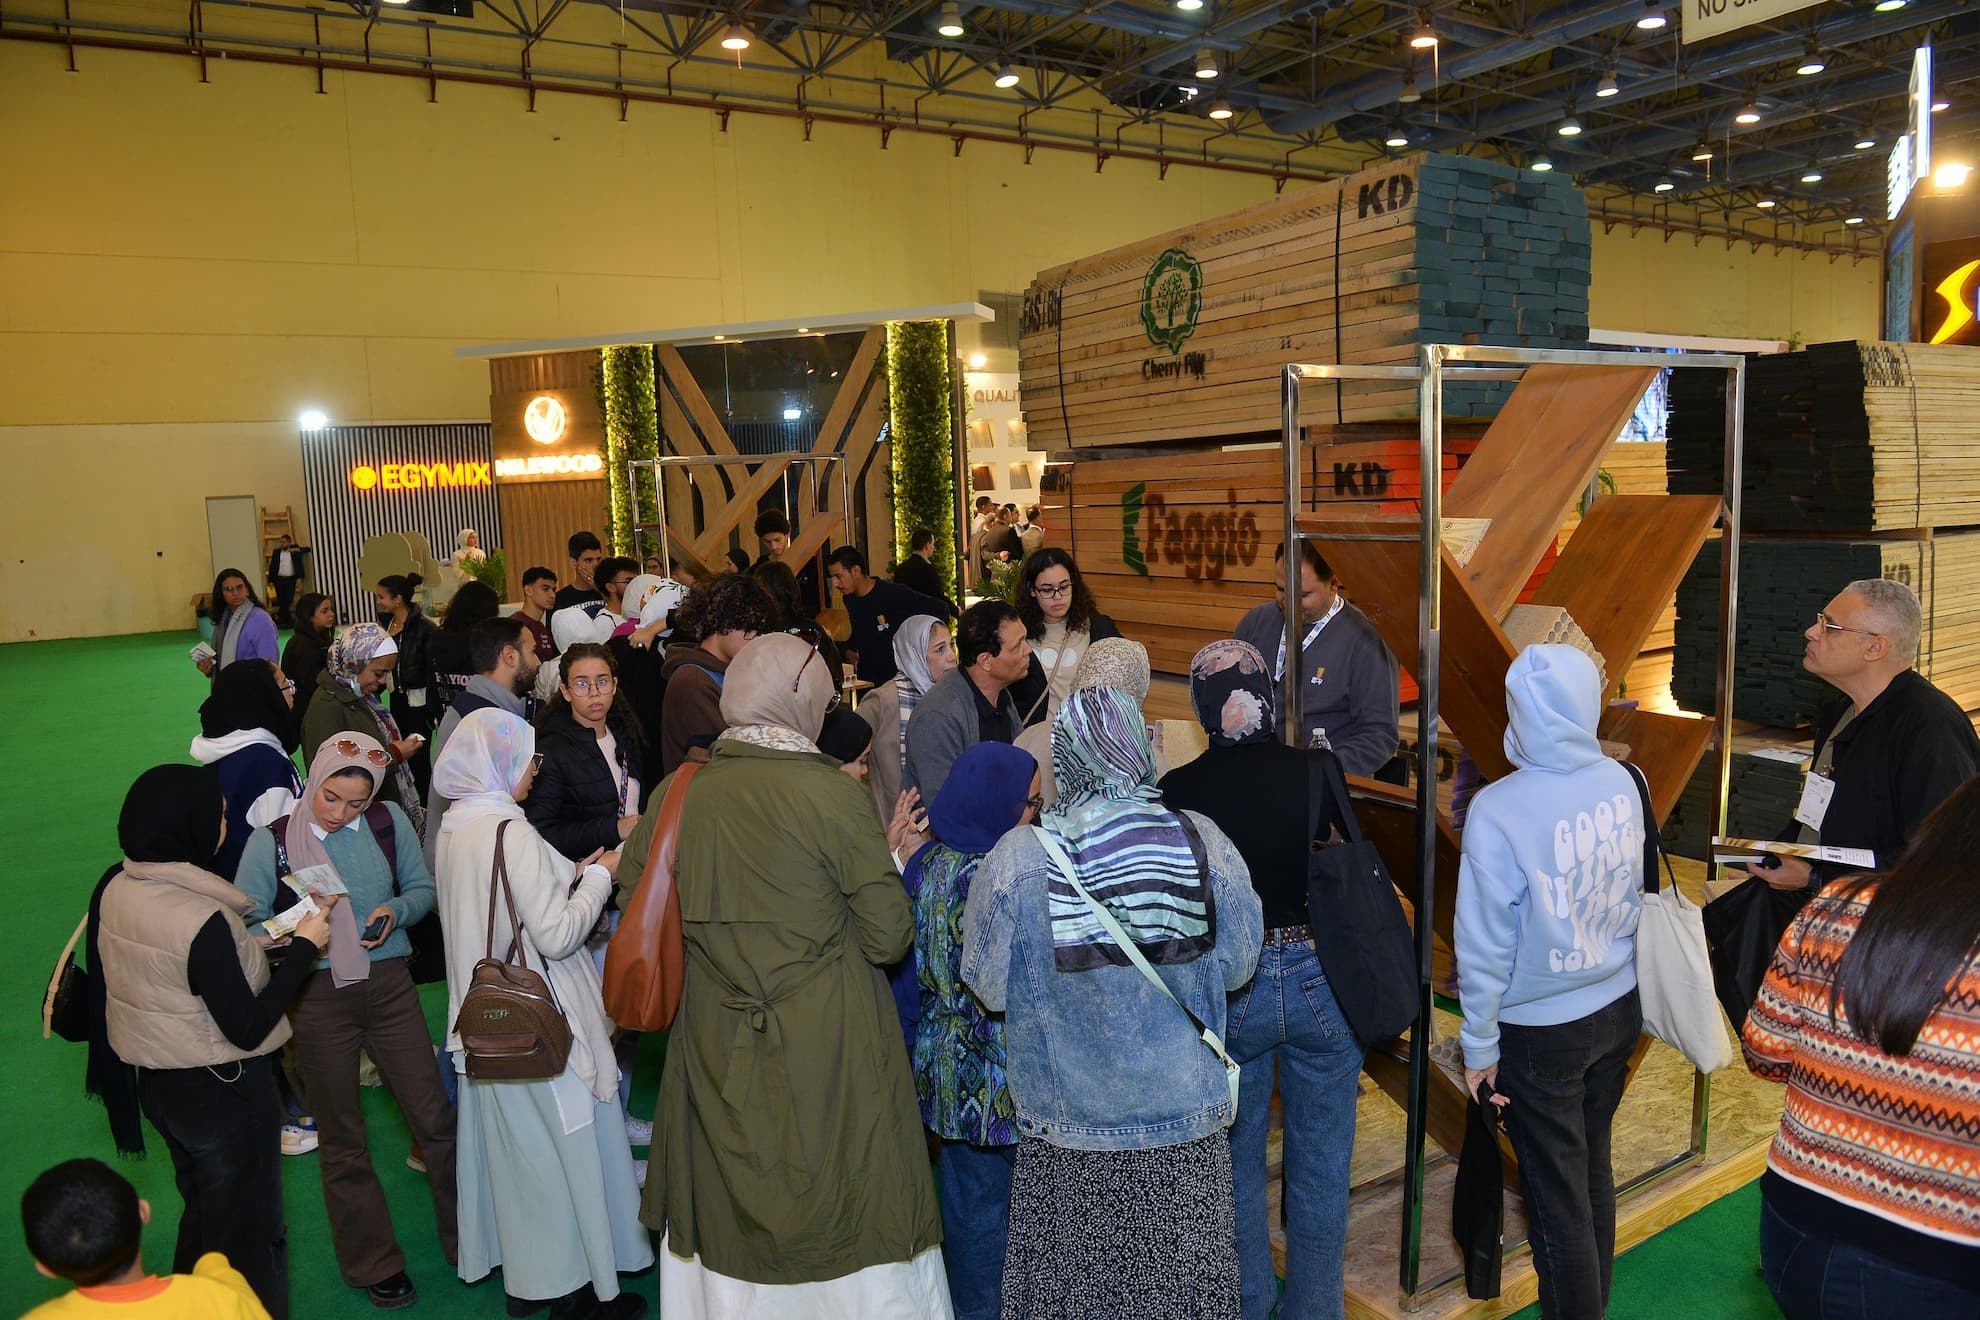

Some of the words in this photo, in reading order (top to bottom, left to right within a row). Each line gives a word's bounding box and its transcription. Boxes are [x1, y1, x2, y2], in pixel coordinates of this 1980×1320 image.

[1358, 174, 1413, 219] KD
[1143, 358, 1181, 381] Cherry
[381, 461, 493, 490] EGYMIX
[495, 454, 603, 477] NILEWOOD
[1333, 462, 1388, 497] KD
[1145, 488, 1261, 581] Faggio
[1554, 794, 1632, 874] GOOD
